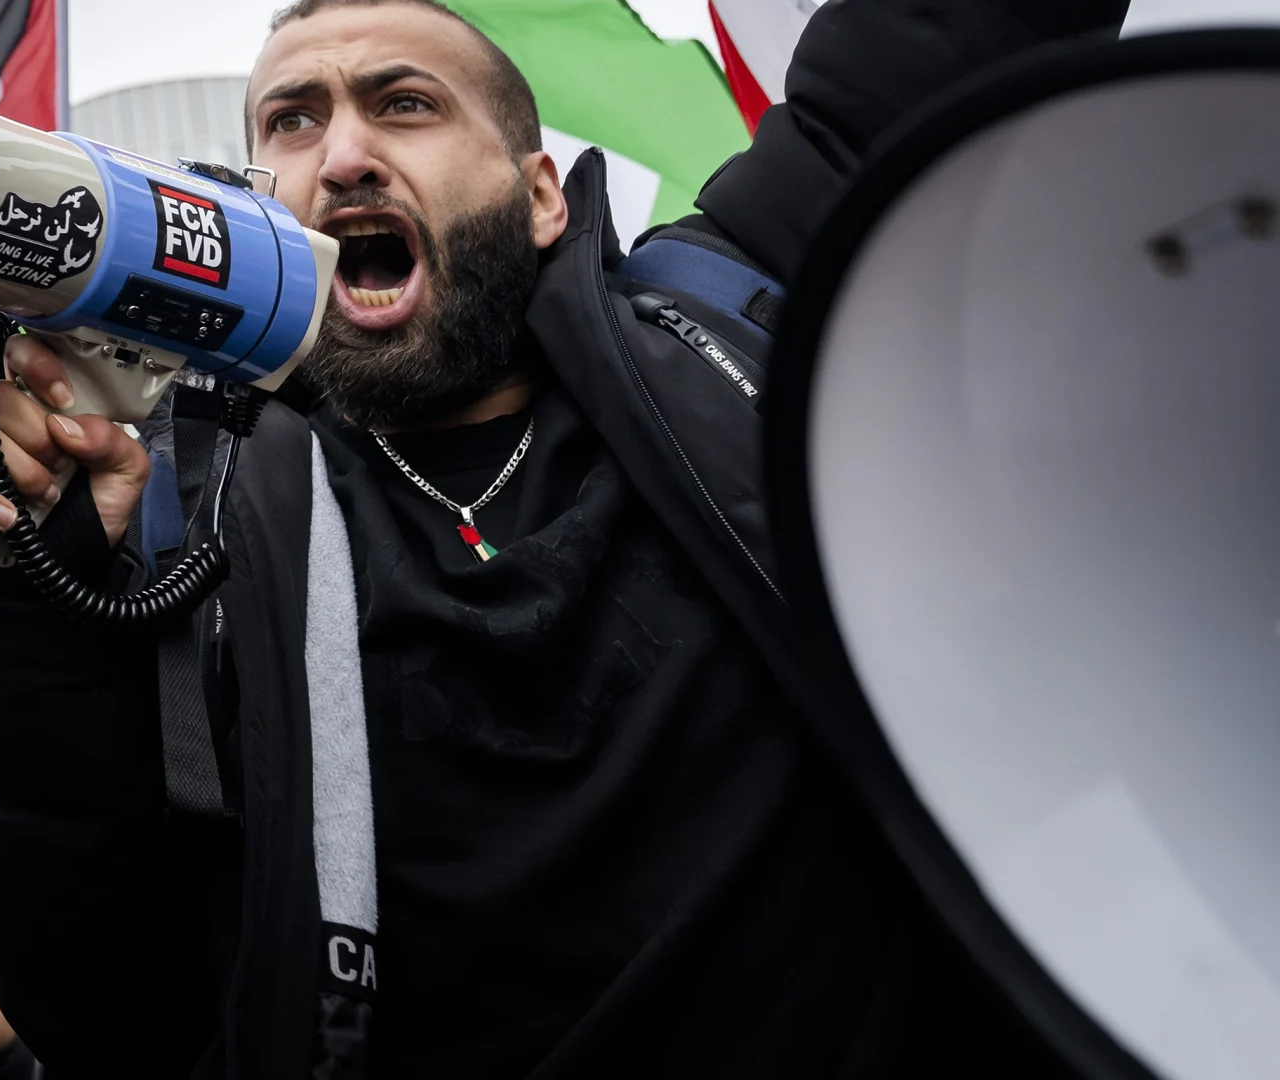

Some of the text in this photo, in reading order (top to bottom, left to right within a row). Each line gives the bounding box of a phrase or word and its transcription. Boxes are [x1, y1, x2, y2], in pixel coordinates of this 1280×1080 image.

[44, 209, 72, 242] لن
[161, 195, 222, 238] FCK
[24, 250, 55, 268] LIVE
[165, 225, 223, 268] FVD
[116, 361, 129, 370] OFF
[705, 344, 758, 398] CARS JEANS 1982
[328, 935, 377, 991] CA
